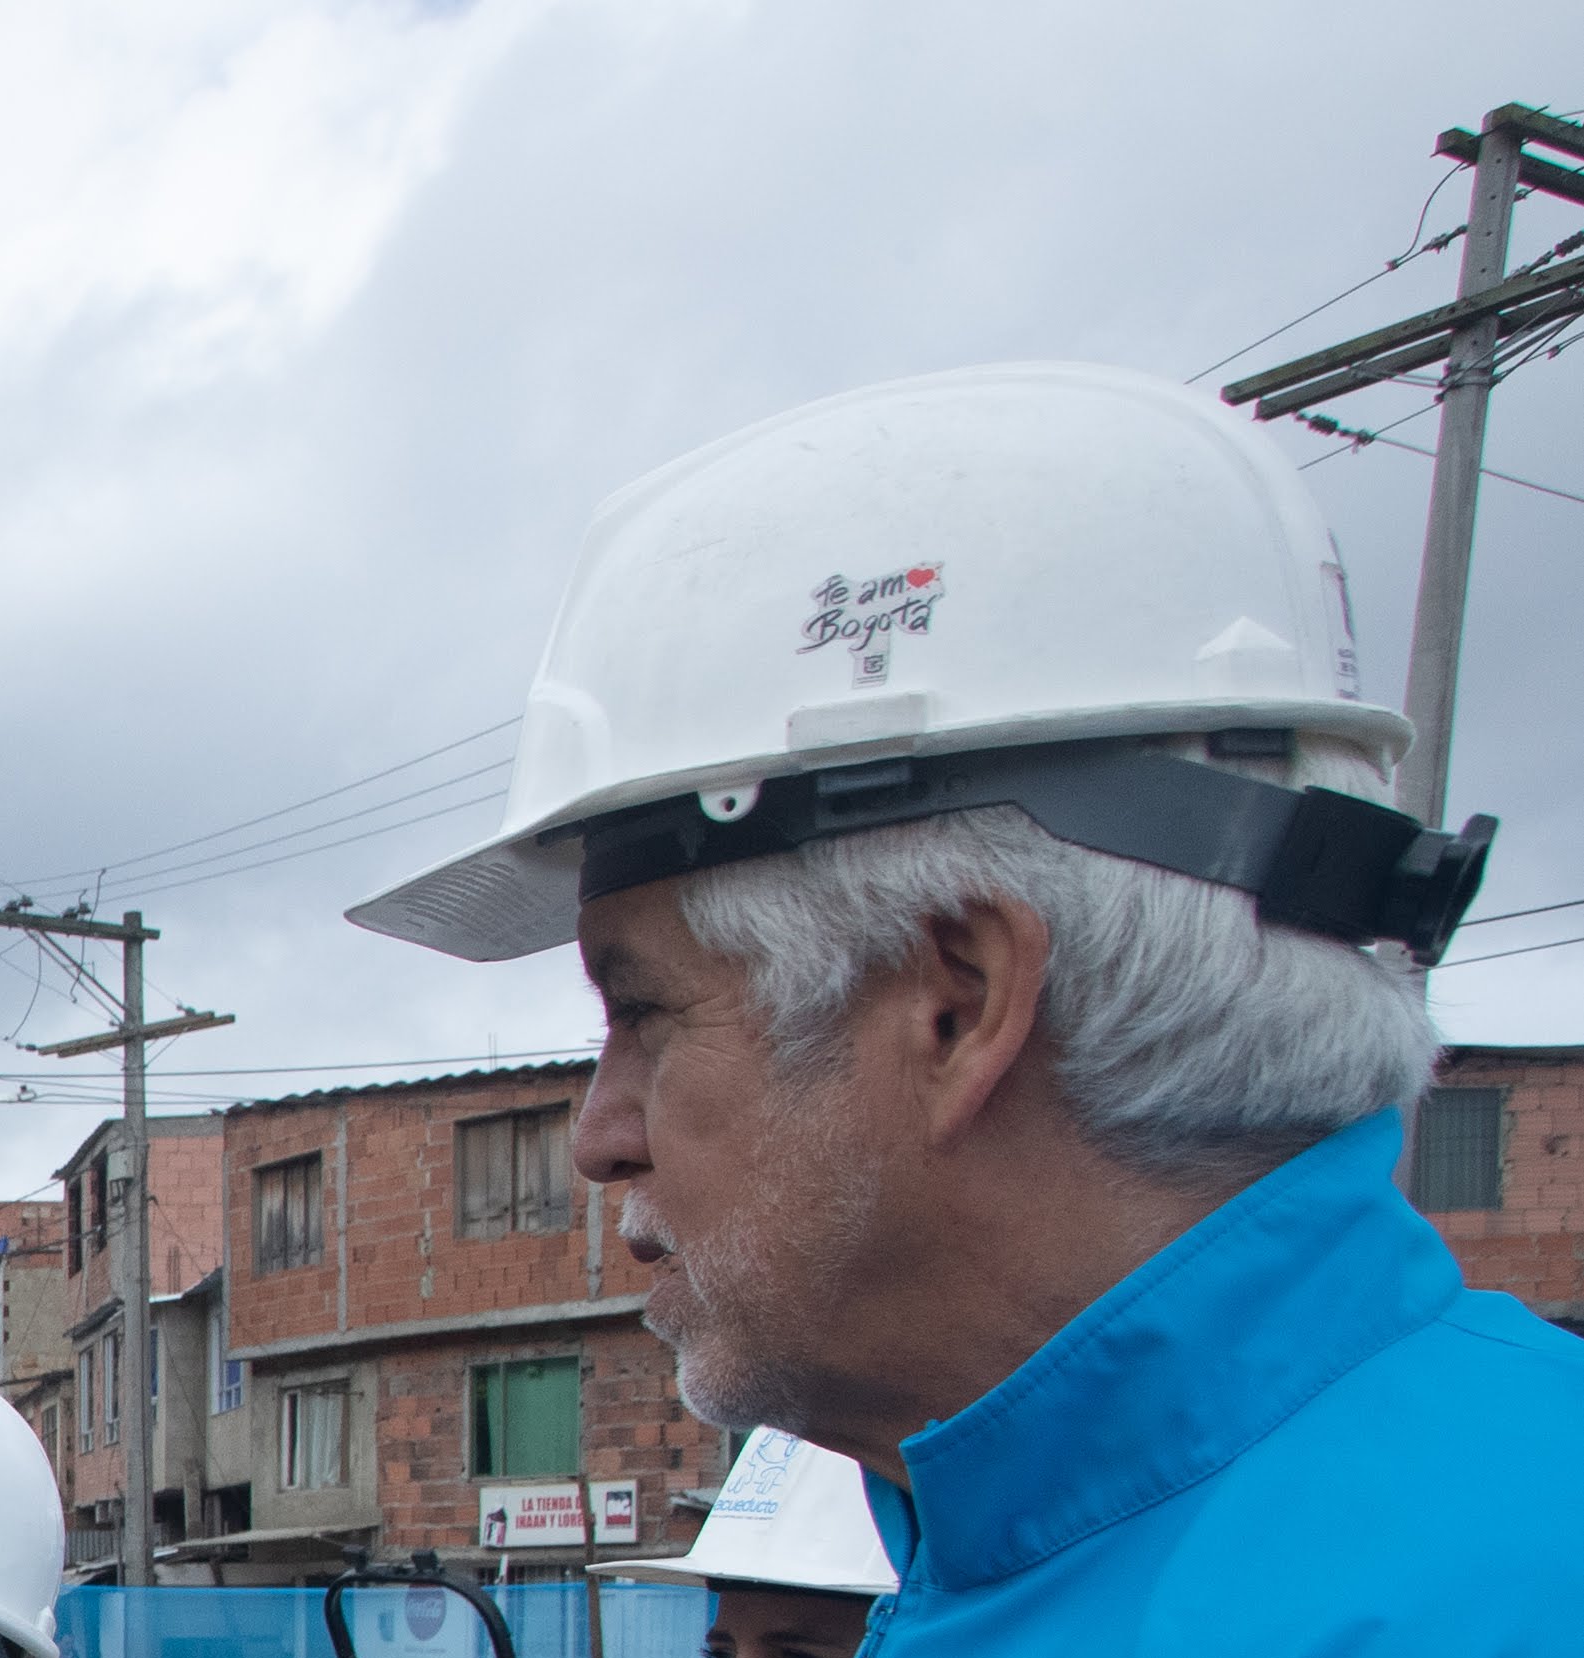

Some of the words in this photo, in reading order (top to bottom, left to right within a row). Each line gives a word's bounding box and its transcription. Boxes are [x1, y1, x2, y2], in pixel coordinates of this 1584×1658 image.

[795, 592, 943, 654] Bogotá
[522, 1497, 533, 1512] LA
[537, 1496, 572, 1511] TIENDA
